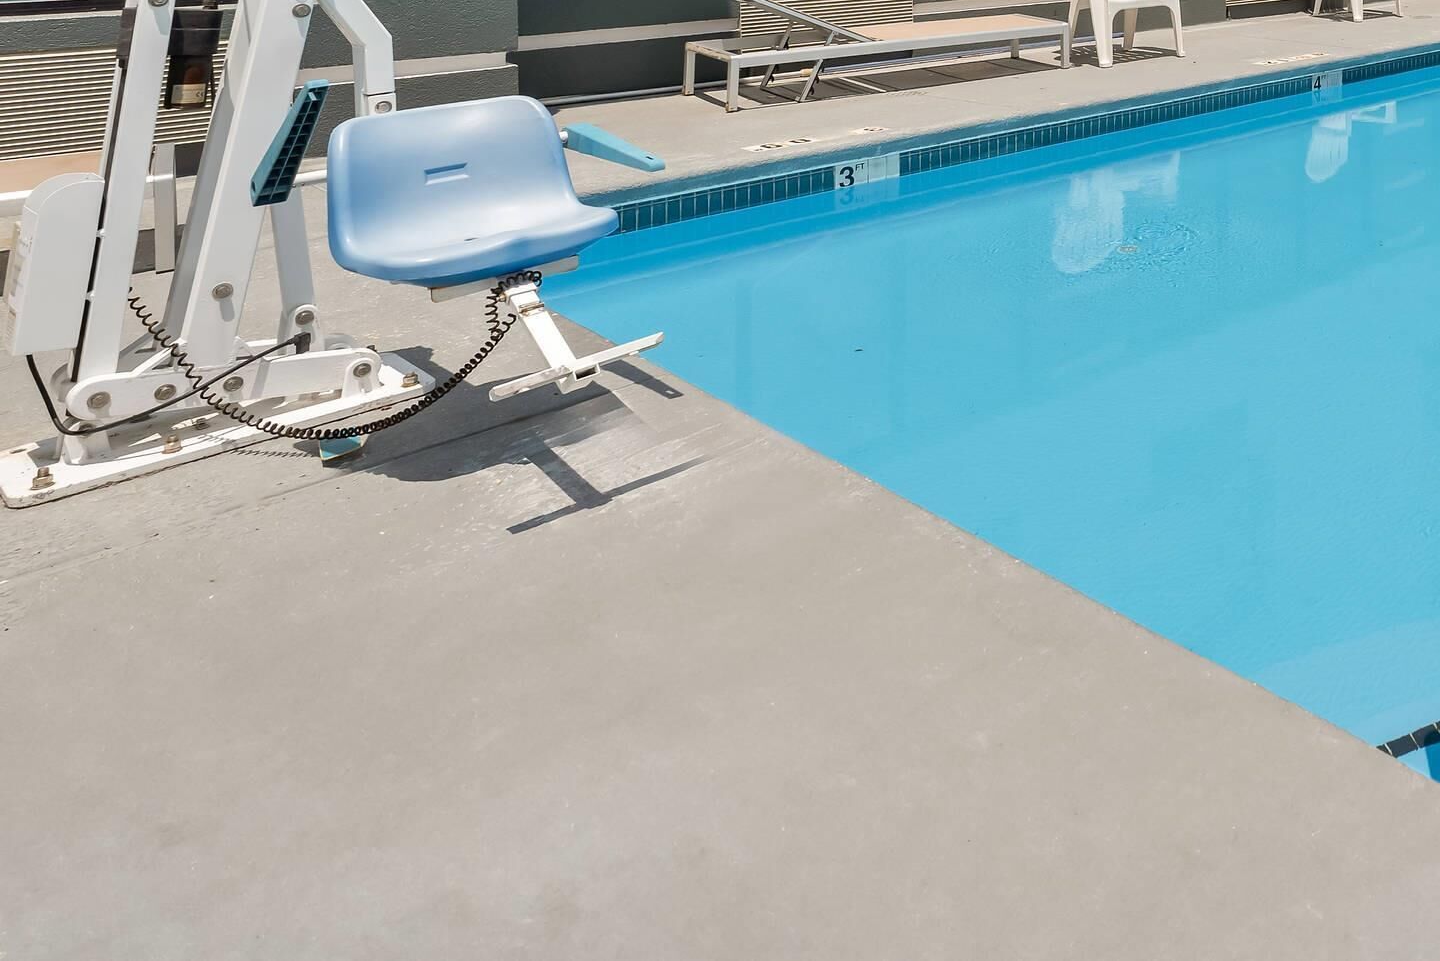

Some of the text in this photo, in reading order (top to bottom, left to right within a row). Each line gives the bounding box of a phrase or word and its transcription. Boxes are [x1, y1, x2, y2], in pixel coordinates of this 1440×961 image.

[1313, 75, 1321, 89] 4
[839, 162, 865, 187] 3 FT
